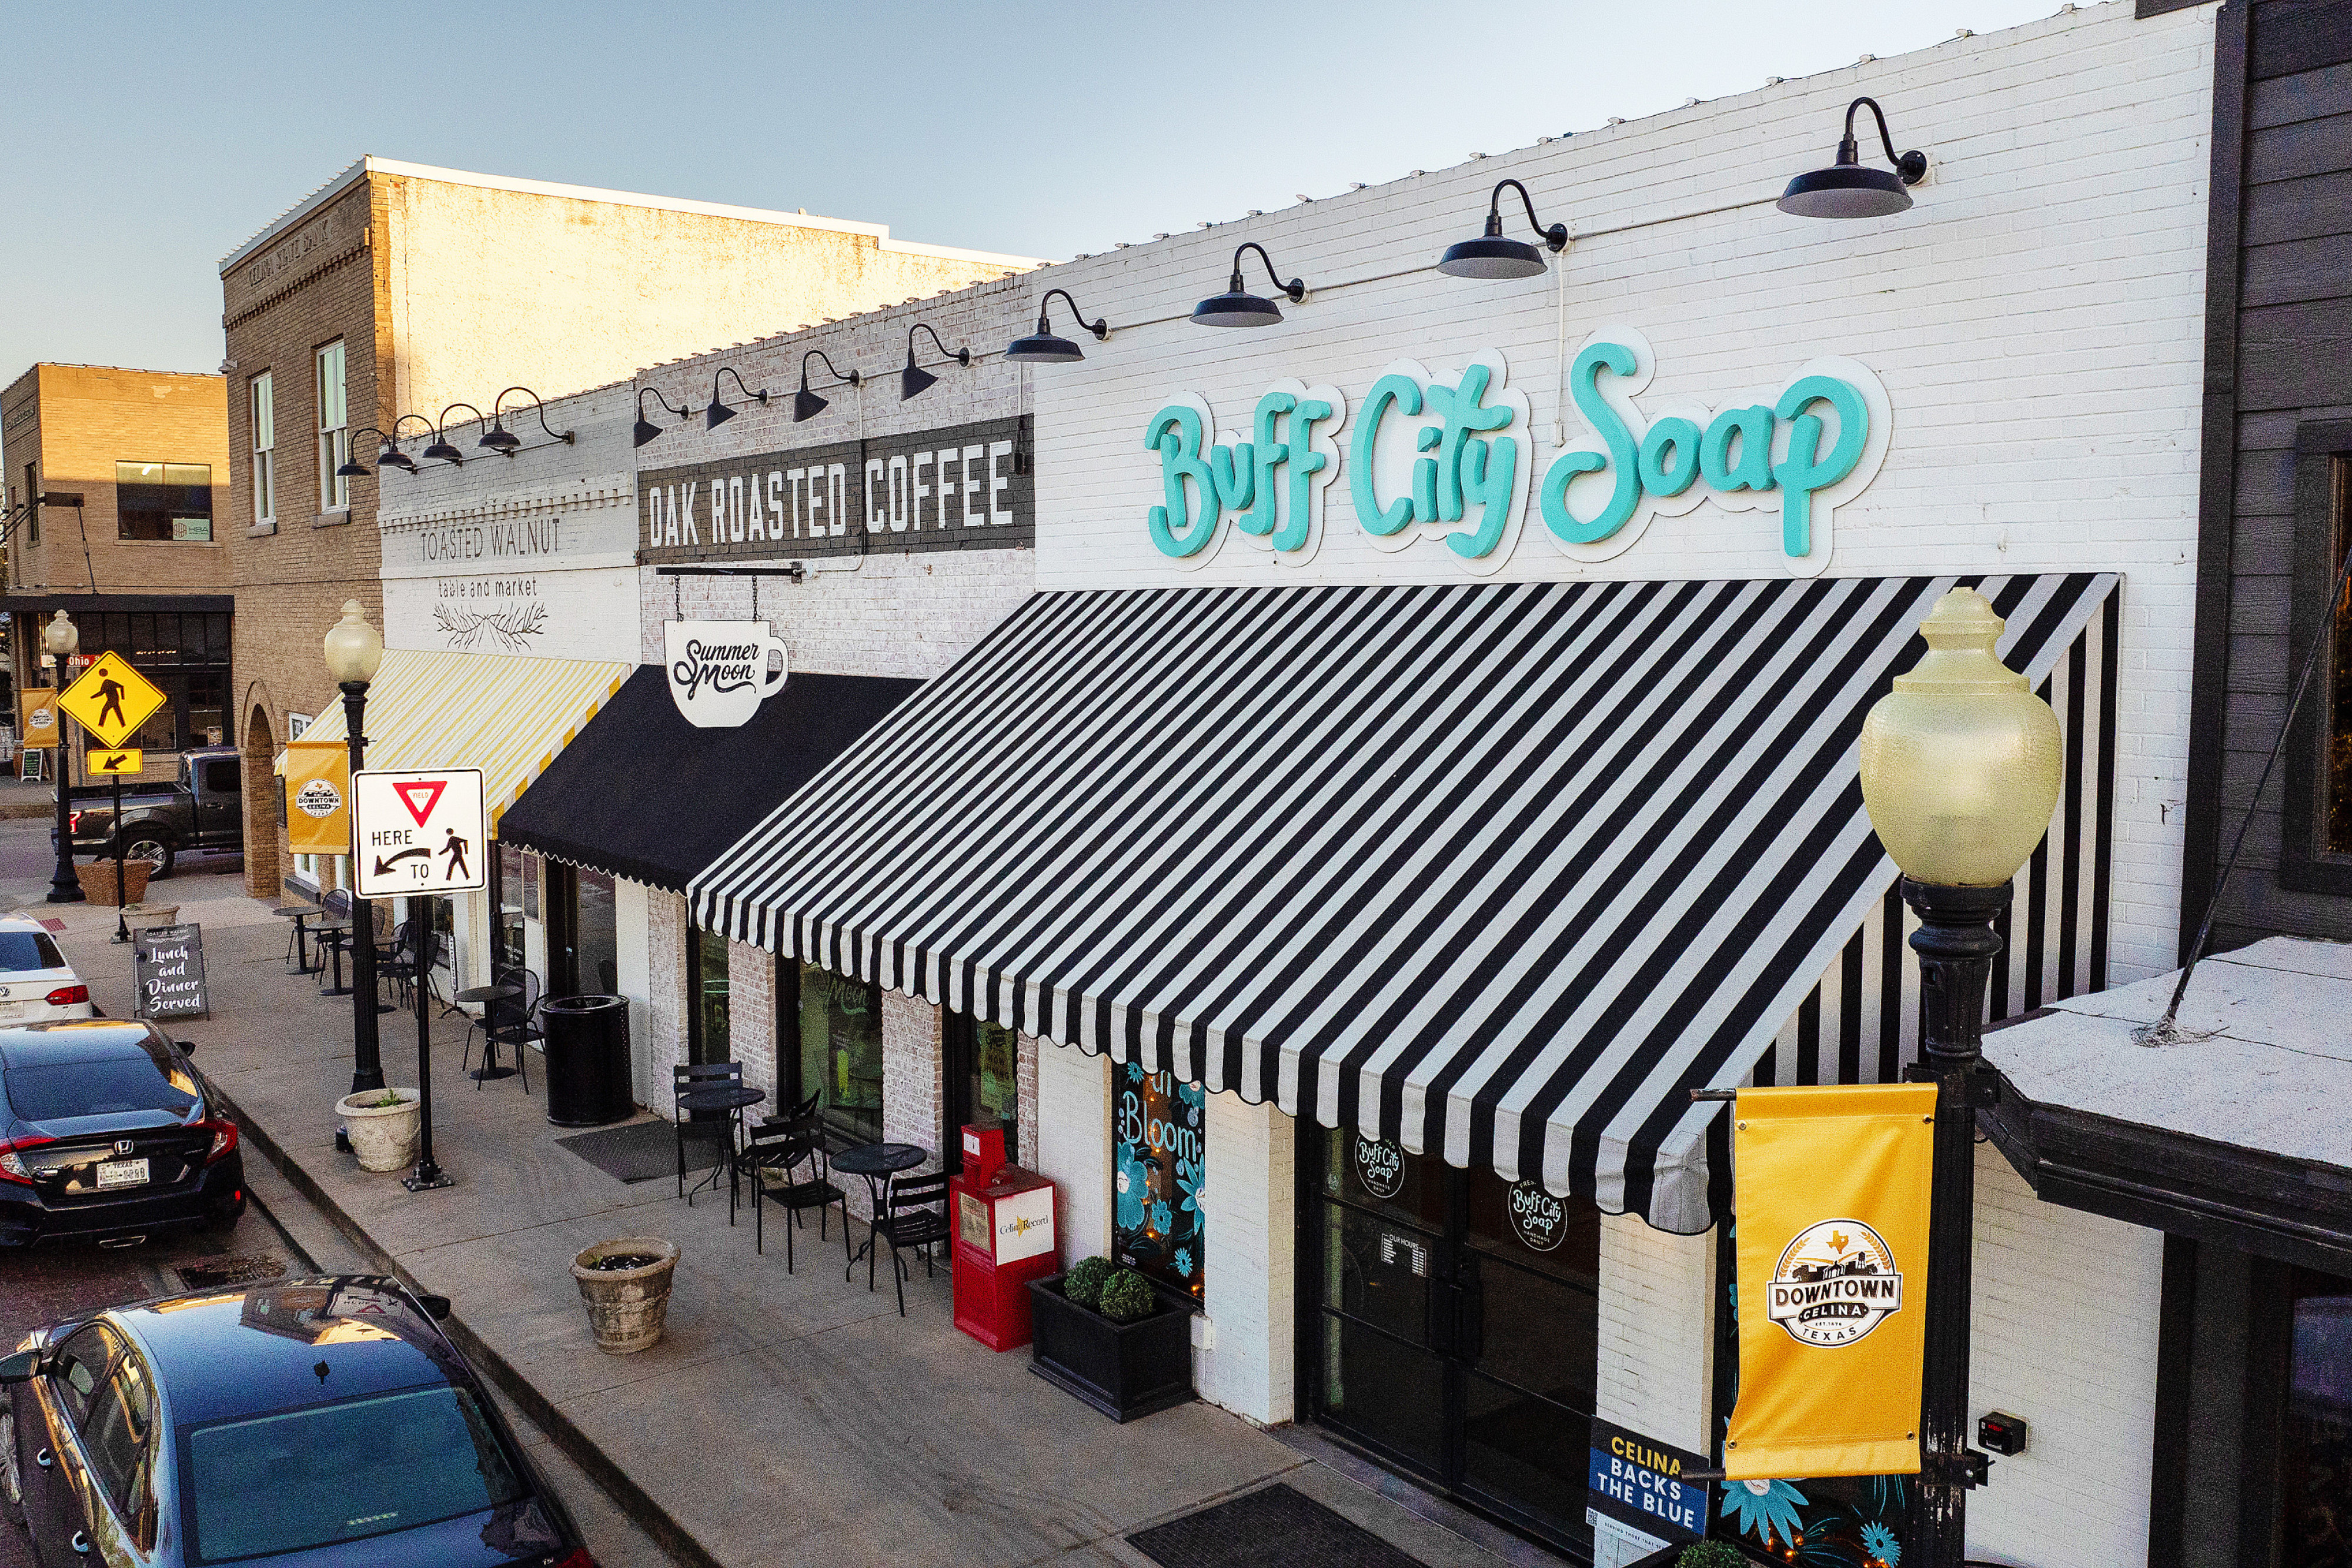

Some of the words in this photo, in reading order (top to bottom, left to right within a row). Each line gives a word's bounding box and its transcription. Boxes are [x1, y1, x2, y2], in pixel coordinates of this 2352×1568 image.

[277, 239, 300, 269] STATE
[303, 219, 329, 252] BANK
[1145, 391, 1331, 557] Buff
[1350, 363, 1515, 559] City
[1540, 341, 1869, 557] Soap
[650, 482, 699, 547] OAK
[712, 463, 846, 544] ROASTED
[865, 440, 1013, 533] COFFEE
[421, 527, 483, 561] TOASTED
[491, 518, 560, 557] WALNUT
[439, 580, 465, 598] table
[470, 579, 489, 597] and
[495, 576, 537, 596] market
[69, 656, 89, 666] Ohio
[674, 638, 760, 686] Summer
[688, 663, 757, 700] Moon
[372, 830, 413, 846] HERE
[410, 864, 429, 879] TO
[150, 945, 188, 964] Lunch
[159, 961, 185, 977] and
[146, 978, 199, 995] Dinner
[150, 993, 200, 1012] Served
[1123, 1091, 1197, 1162] Bloom
[1359, 1142, 1382, 1164] Buff
[1383, 1148, 1399, 1171] City
[1368, 1161, 1392, 1183] Soap
[1519, 1179, 1536, 1189] FRES
[1514, 1189, 1541, 1213] Buff
[1541, 1197, 1561, 1222] City
[1000, 1223, 1023, 1235] Celina
[1023, 1215, 1048, 1229] Record
[1523, 1210, 1553, 1236] Soap
[1389, 1234, 1400, 1243] OUR
[1401, 1238, 1419, 1251] HOURS
[1523, 1230, 1551, 1243] HANDMADE
[1776, 1280, 1894, 1307] DOWNTOWN
[1803, 1305, 1862, 1320] CELINA
[1803, 1327, 1856, 1340] TEXAS
[1611, 1437, 1681, 1475] CELINA
[1611, 1457, 1681, 1500] BACKS
[1598, 1472, 1633, 1504] THE
[1643, 1492, 1694, 1529] BLUE
[1605, 1522, 1623, 1533] SERVING
[1625, 1532, 1640, 1540] THOSE
